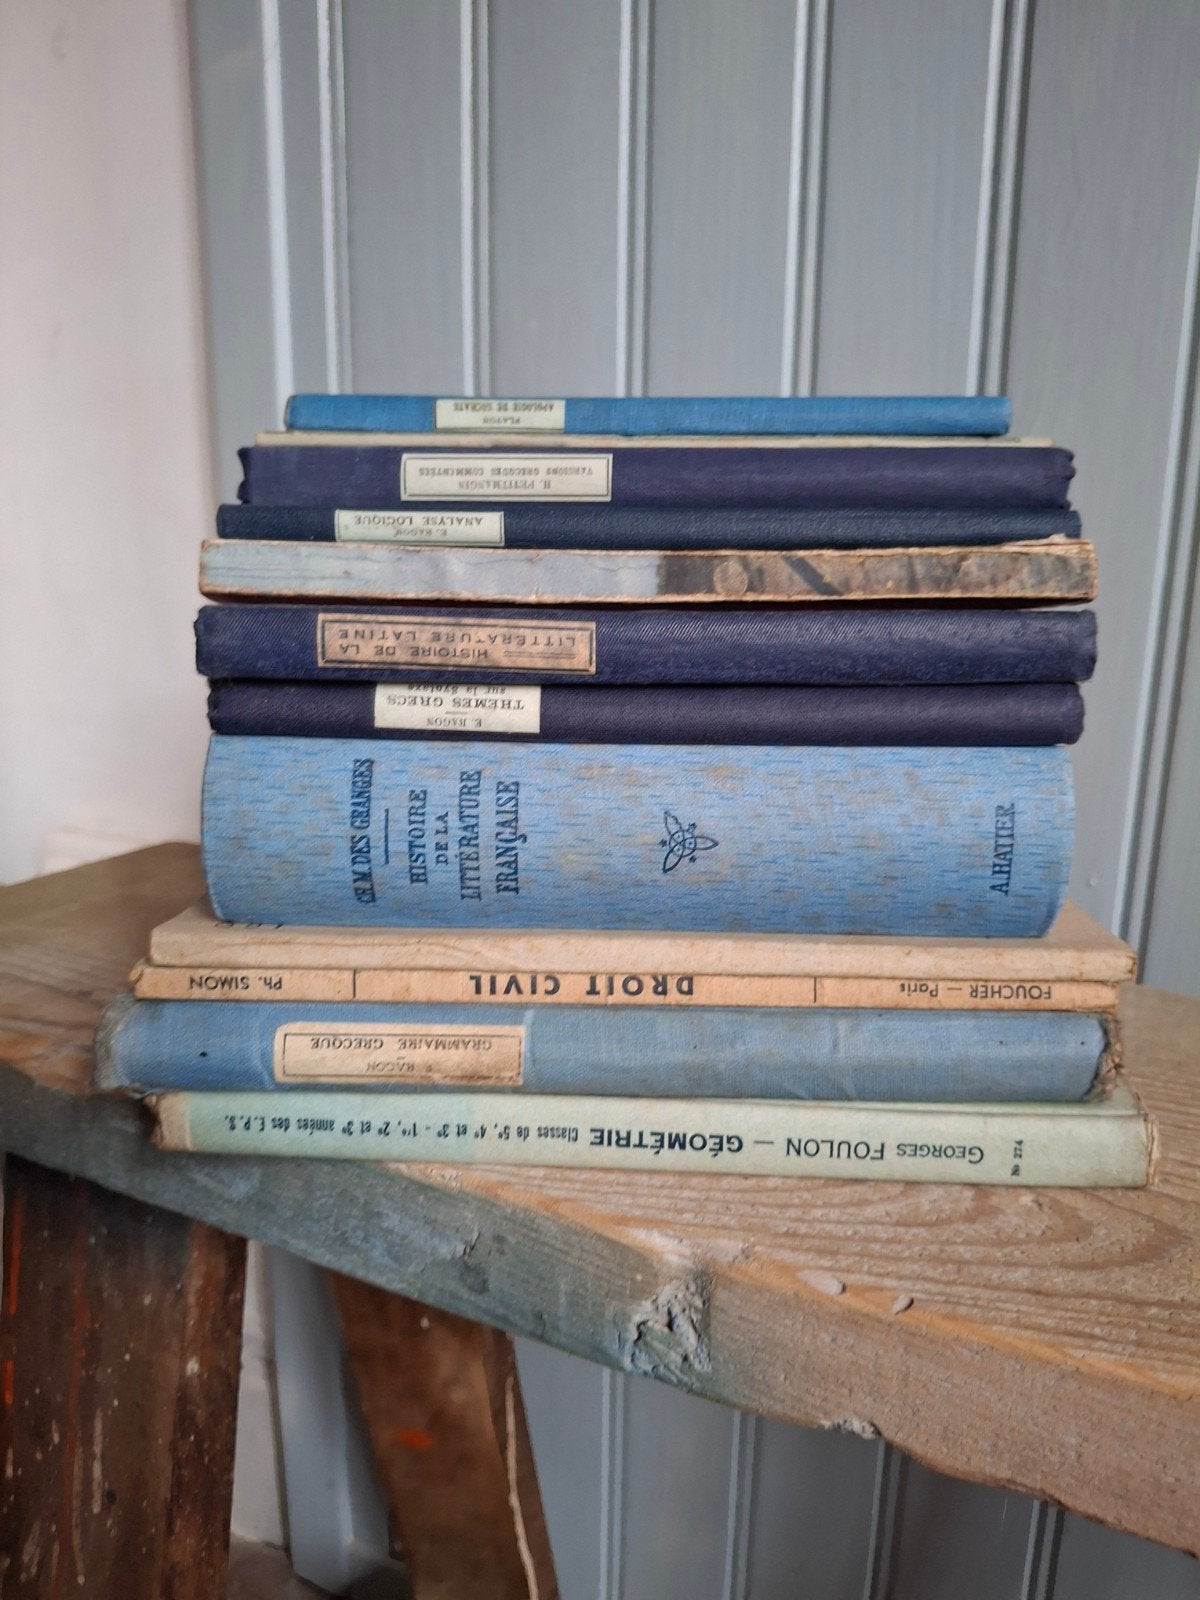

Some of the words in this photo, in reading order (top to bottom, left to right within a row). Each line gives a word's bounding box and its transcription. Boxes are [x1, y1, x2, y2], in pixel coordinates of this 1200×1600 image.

[453, 402, 492, 411] SOCRATE
[496, 403, 508, 411] DE
[458, 480, 534, 490] PETITMANGIN
[354, 515, 413, 526] LOGIQUE
[423, 516, 483, 526] ANALYSE
[338, 628, 416, 641] LATINE
[339, 644, 360, 655] LA
[374, 645, 396, 656] DE
[409, 647, 488, 659] HISTOIRE
[466, 686, 477, 696] la
[484, 687, 506, 695] sur
[386, 695, 443, 707] GRECS
[350, 758, 375, 830] GRANGES
[436, 812, 448, 835] LA
[408, 789, 428, 885] HISTOIRE
[455, 770, 482, 901] LITTÉRATURE
[496, 781, 527, 895] FRANÇAISE
[435, 841, 448, 865] DE
[189, 976, 250, 990] SIMON
[258, 976, 283, 990] Ph.
[469, 975, 560, 995] CIVIL
[586, 975, 694, 996] DROIT
[900, 983, 939, 997] Paris
[969, 984, 1052, 1000] FOUCHER
[310, 1036, 384, 1049] GRECQUE
[397, 1038, 492, 1051] GRAMMAIRE
[271, 1117, 290, 1133] des
[297, 1118, 335, 1136] années
[361, 1121, 371, 1135] et
[457, 1124, 467, 1137] et
[517, 1126, 529, 1142] de
[537, 1127, 578, 1142] Classes
[590, 1128, 744, 1159] GÉOMÉTRIE
[785, 1138, 885, 1160] FOULON
